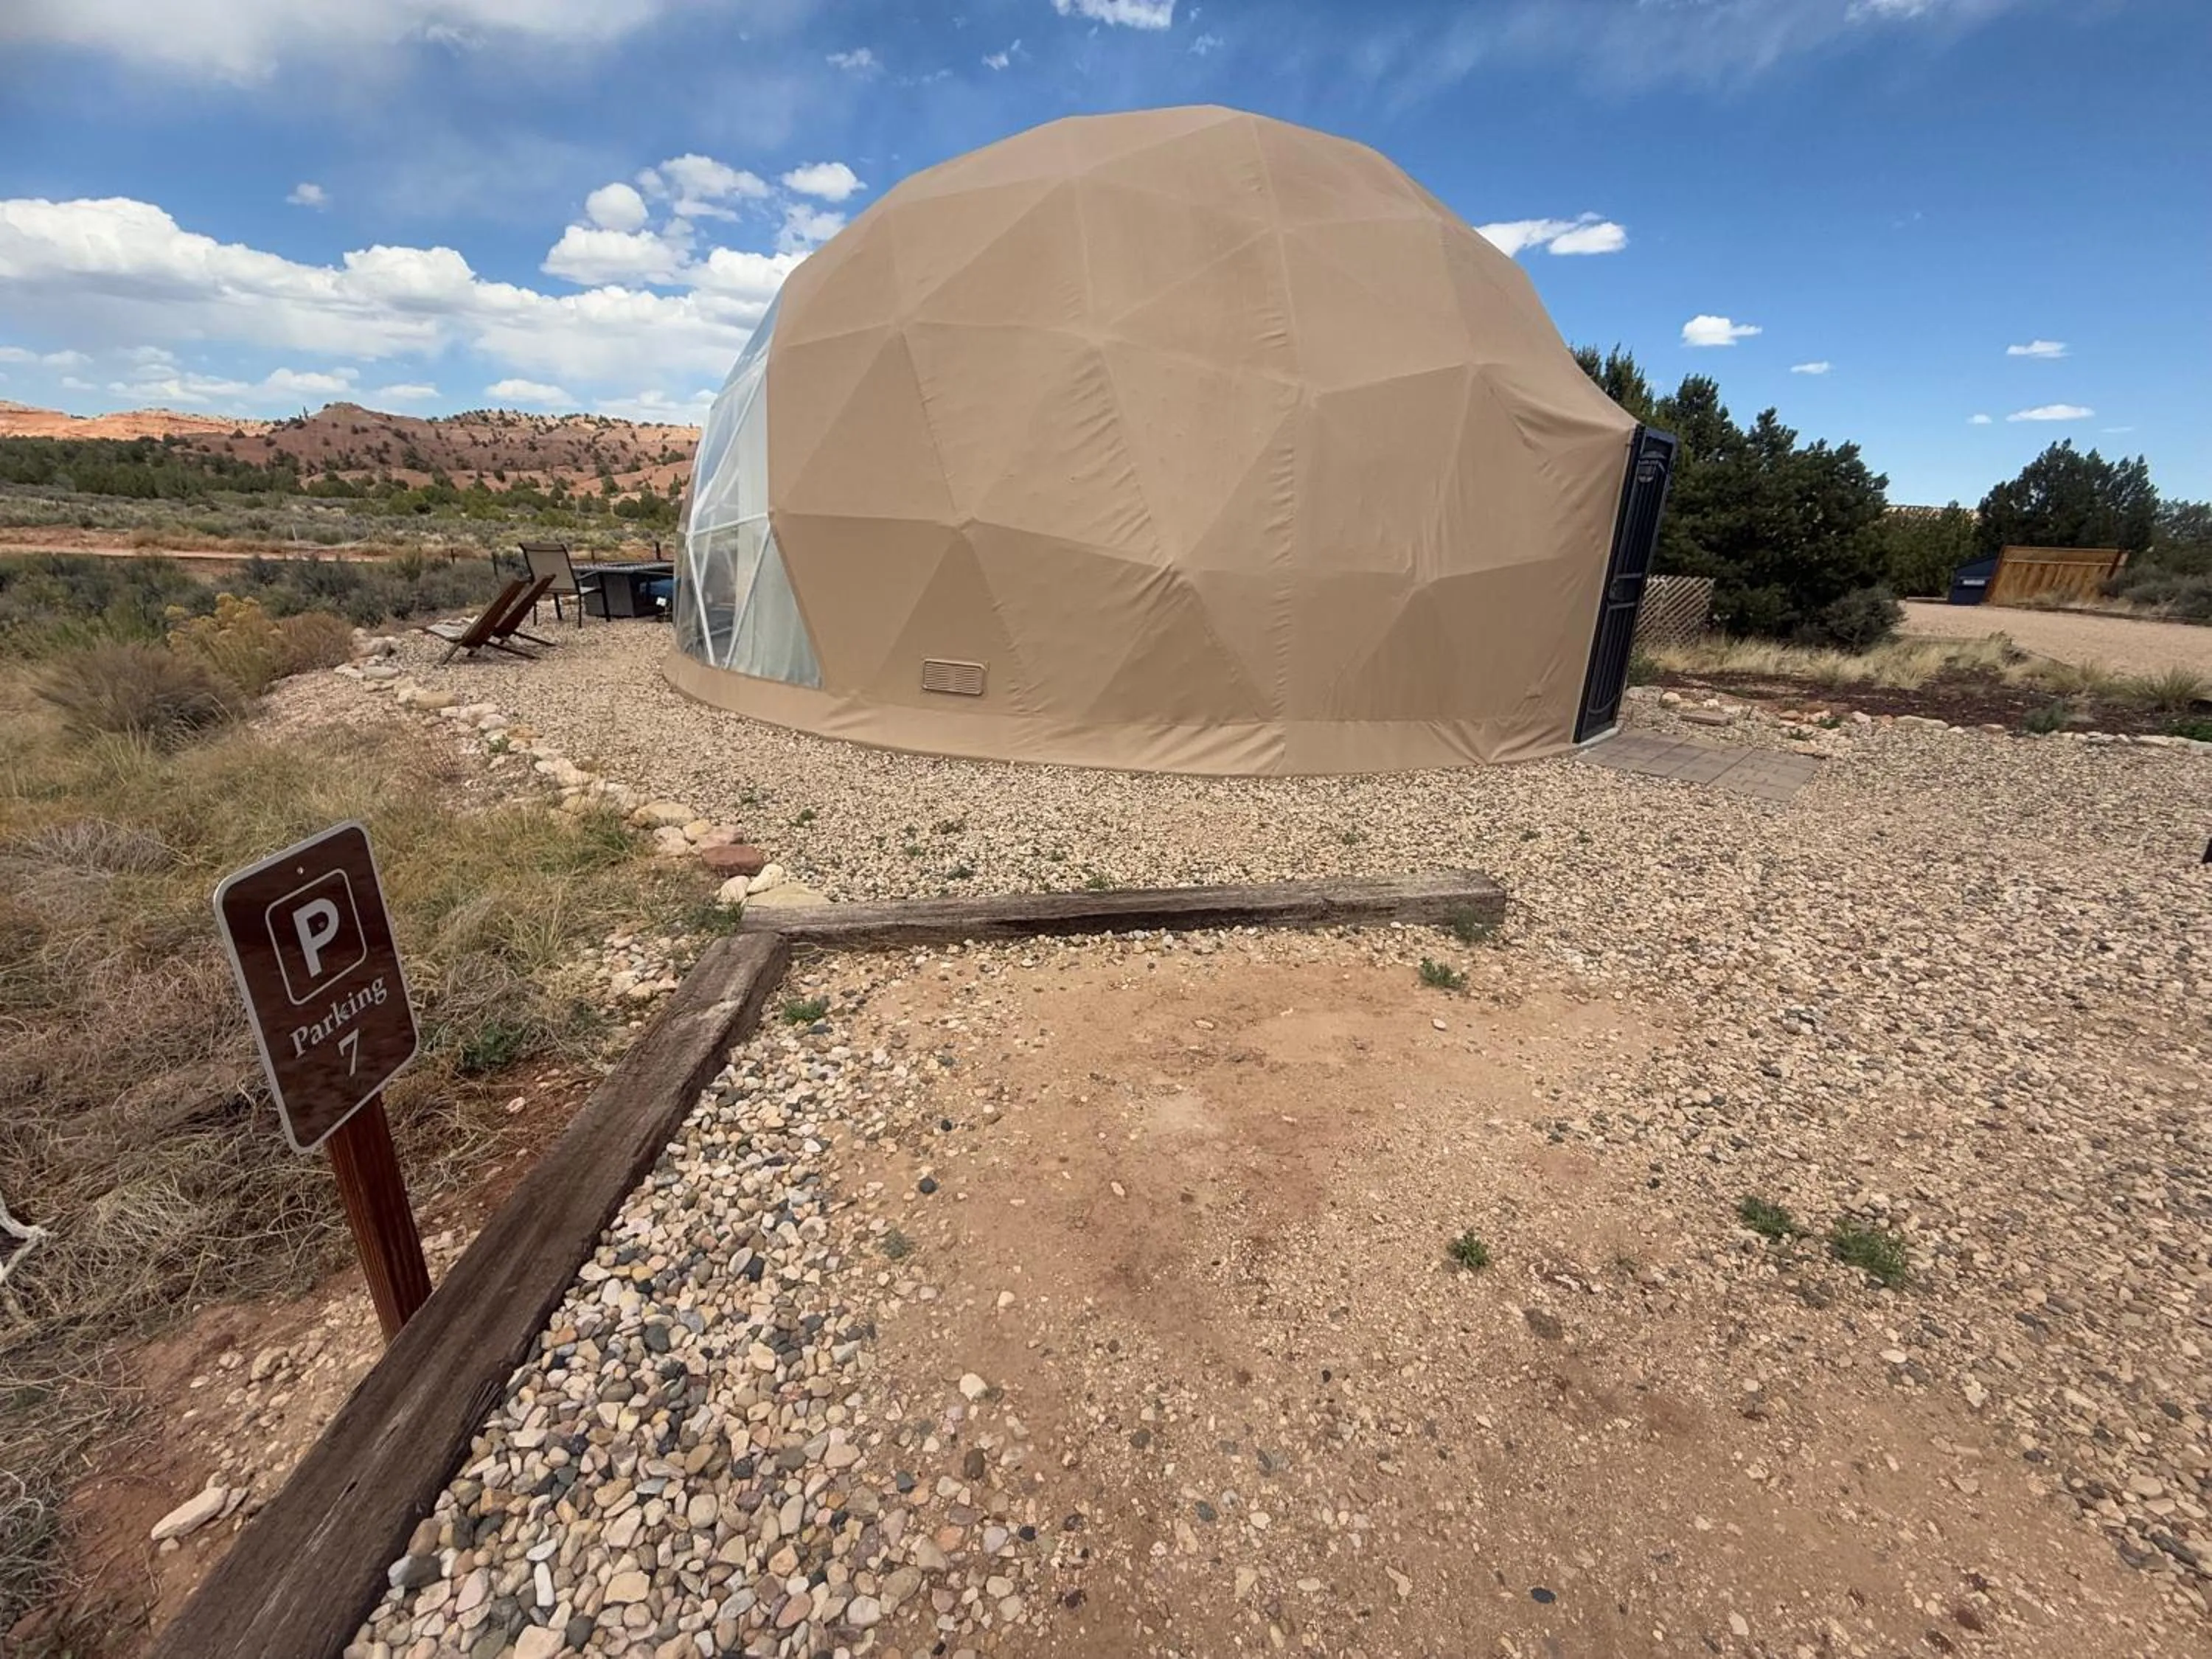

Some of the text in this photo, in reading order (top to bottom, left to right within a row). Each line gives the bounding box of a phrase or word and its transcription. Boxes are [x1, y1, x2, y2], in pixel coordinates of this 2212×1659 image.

[292, 897, 340, 978] P
[290, 976, 388, 1057] Parking
[338, 1029, 360, 1077] 7
